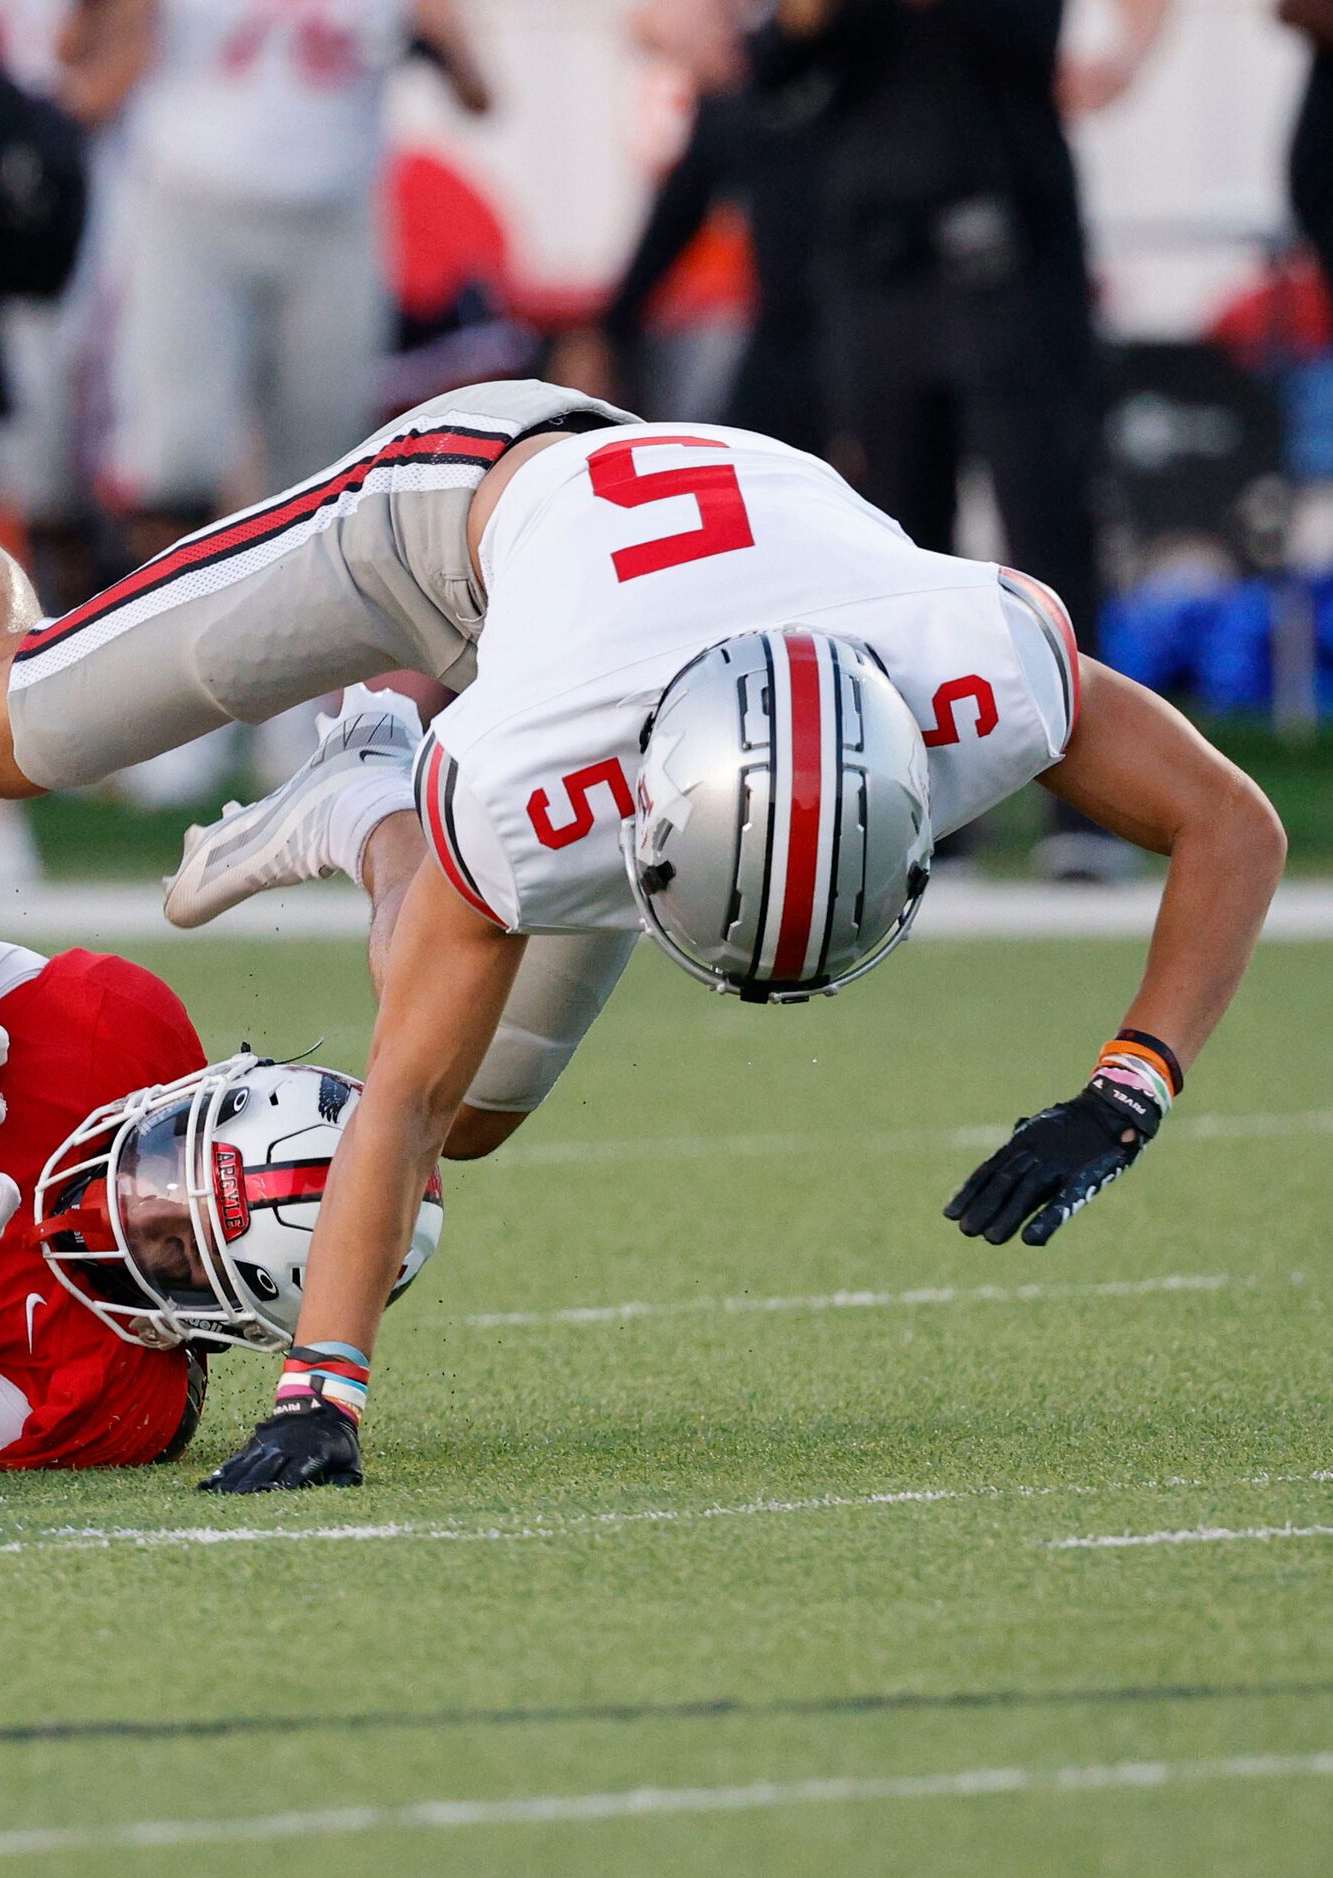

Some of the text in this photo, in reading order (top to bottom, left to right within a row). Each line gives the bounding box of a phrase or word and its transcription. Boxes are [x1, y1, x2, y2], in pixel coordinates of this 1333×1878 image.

[586, 436, 755, 583] 5
[924, 674, 1000, 748] 5
[525, 756, 636, 850] 5
[216, 1151, 245, 1230] ARGYLE
